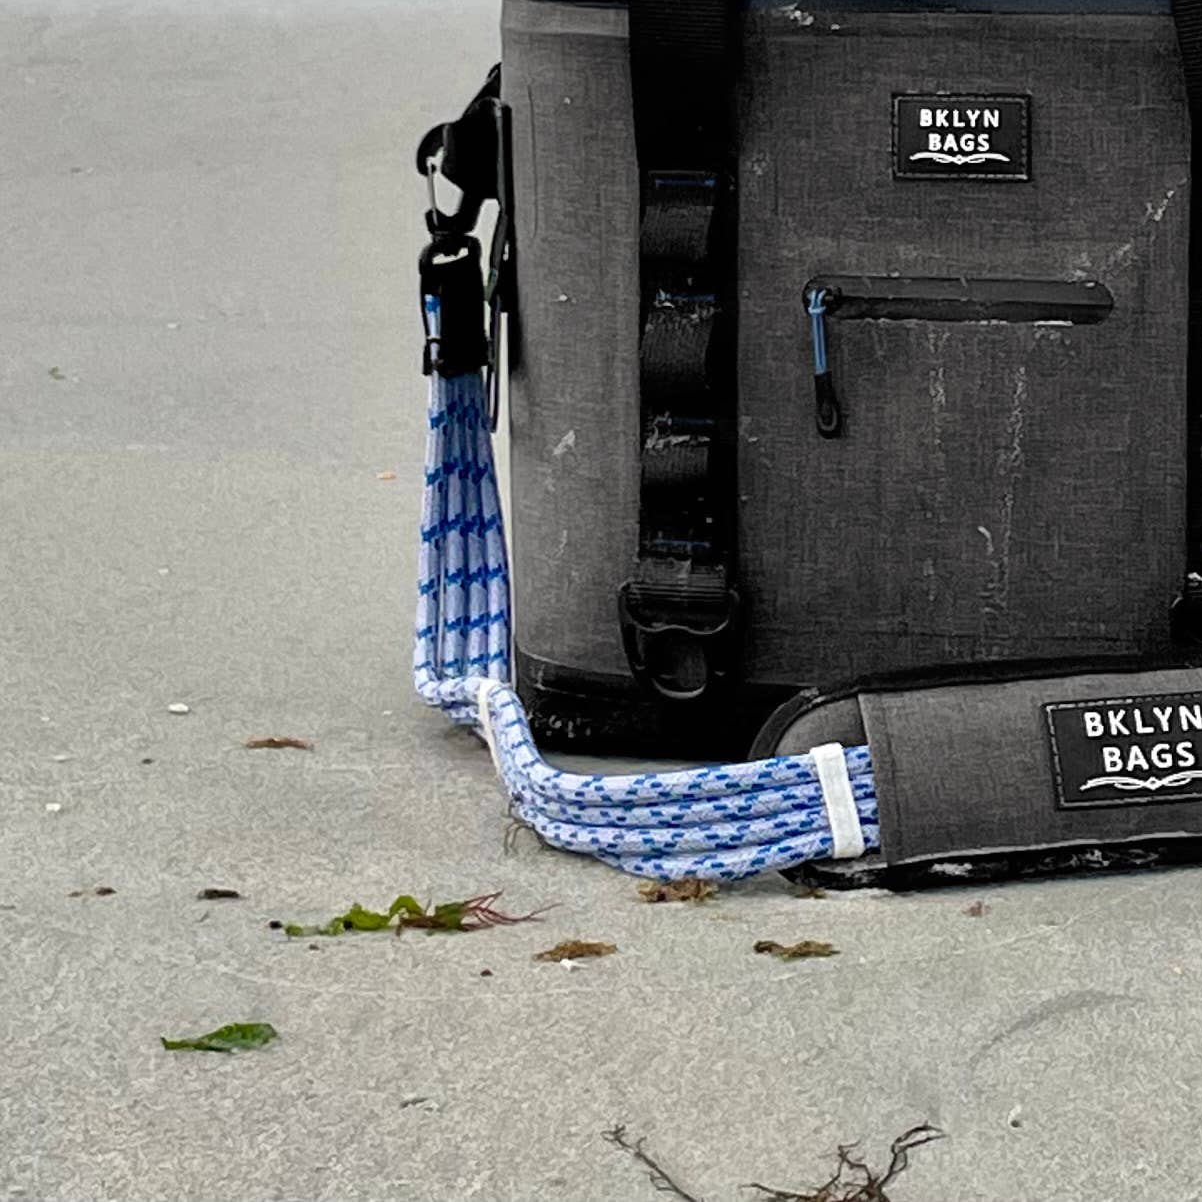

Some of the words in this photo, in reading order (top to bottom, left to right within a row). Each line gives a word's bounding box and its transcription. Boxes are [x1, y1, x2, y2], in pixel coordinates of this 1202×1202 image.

[919, 108, 999, 128] BKLYN
[928, 133, 990, 152] BAGS
[1102, 741, 1196, 773] BAGS
